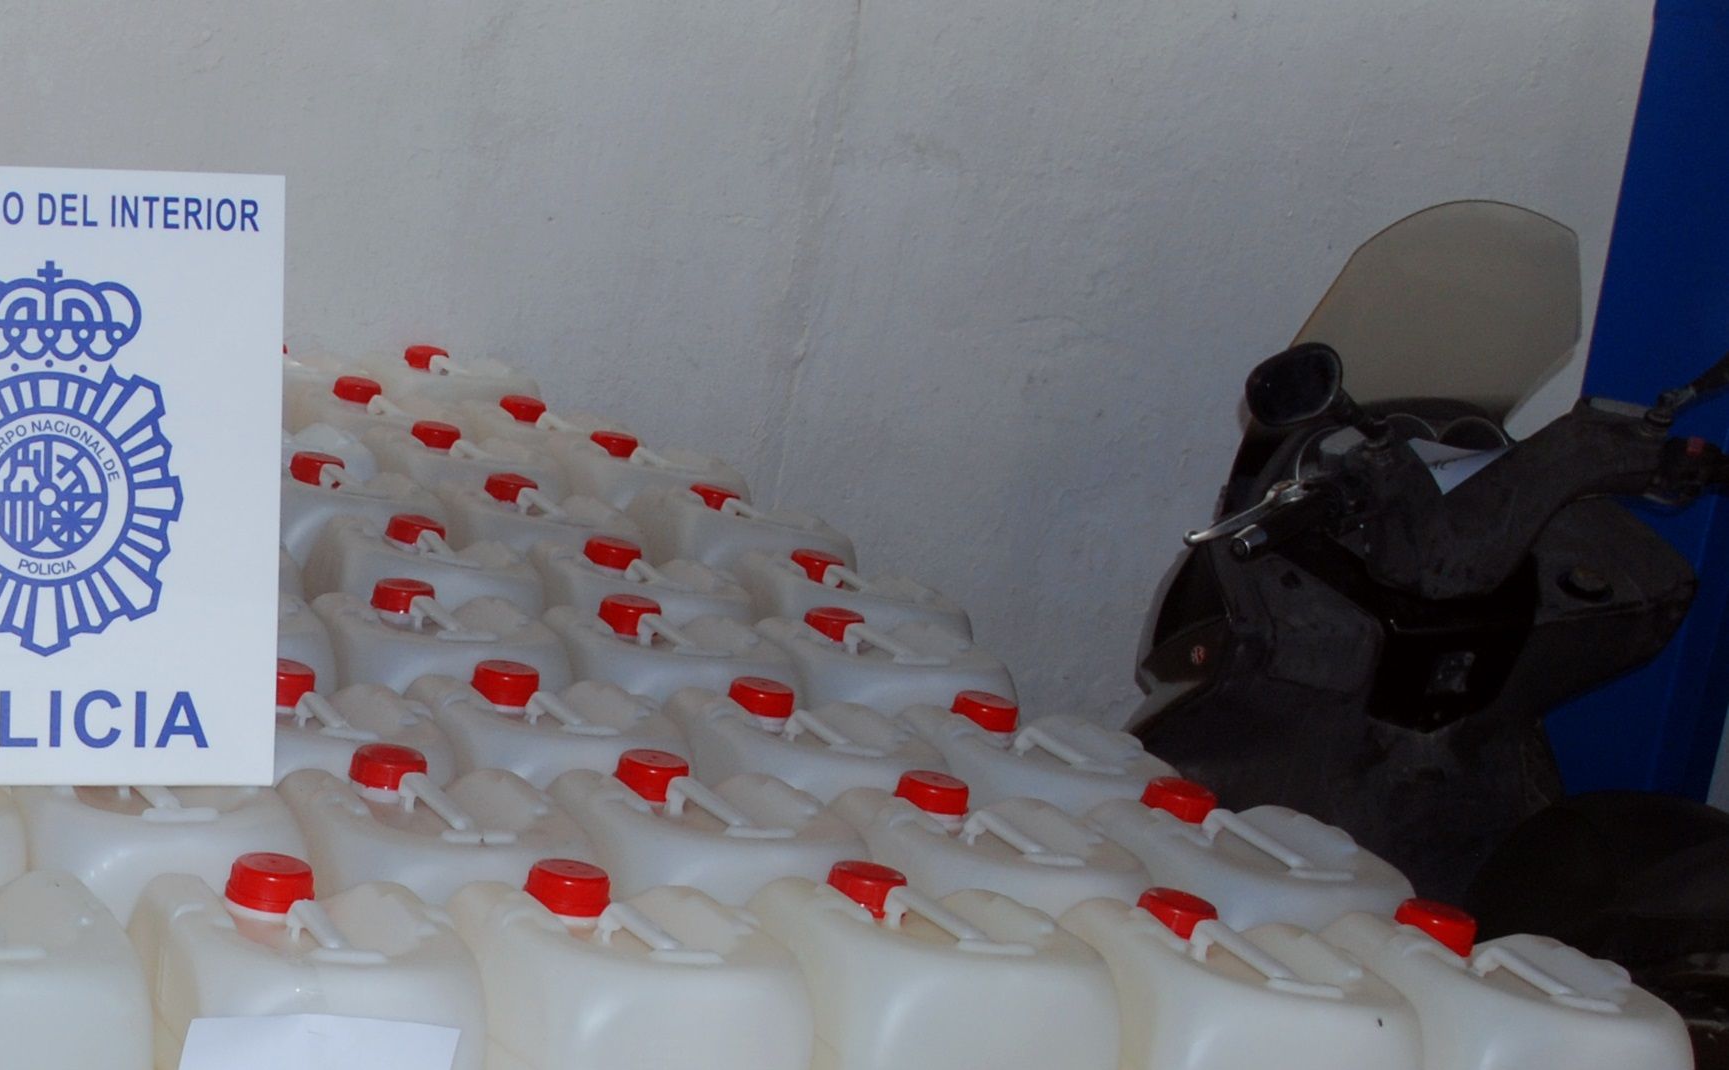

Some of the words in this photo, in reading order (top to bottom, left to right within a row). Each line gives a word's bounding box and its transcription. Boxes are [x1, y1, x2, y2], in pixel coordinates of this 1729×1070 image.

[37, 192, 99, 227] DEL
[110, 194, 260, 232] INTERIOR
[31, 419, 107, 460] NACIONAL
[103, 459, 120, 482] DE
[17, 558, 76, 576] POLICIA
